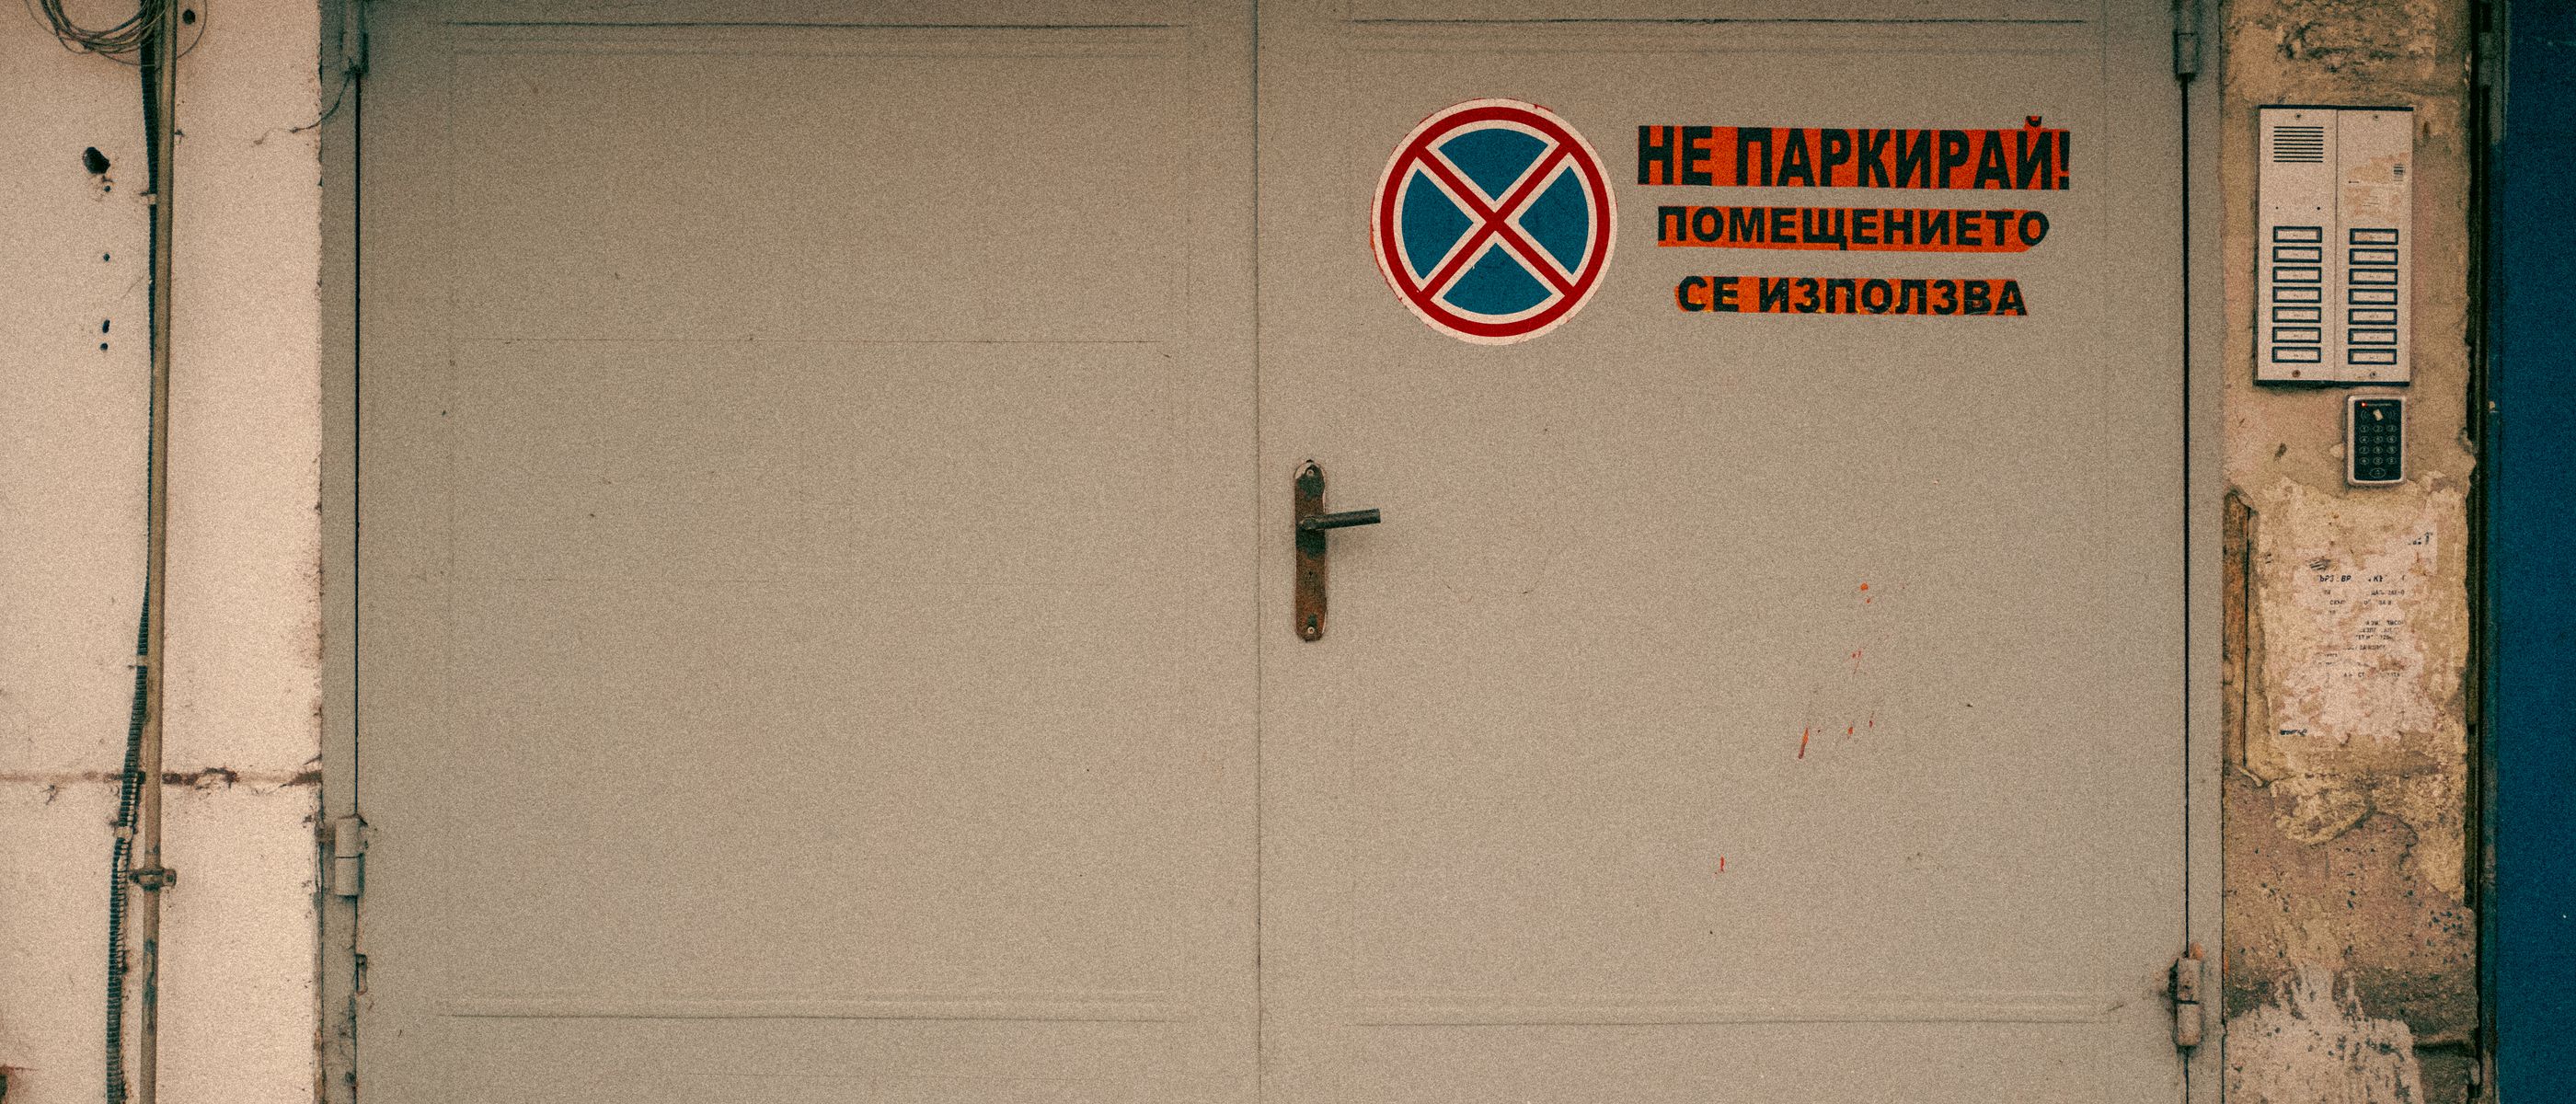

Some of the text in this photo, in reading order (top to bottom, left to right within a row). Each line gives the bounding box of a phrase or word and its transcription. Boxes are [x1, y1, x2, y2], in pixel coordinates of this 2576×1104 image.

[1638, 116, 2070, 190] НЕ ПАРКИРАЙ!
[1658, 206, 2050, 250] ПОМЕЩЕНИЕТО
[1677, 275, 2028, 316] СЕ ИЗПОЛЗВА
